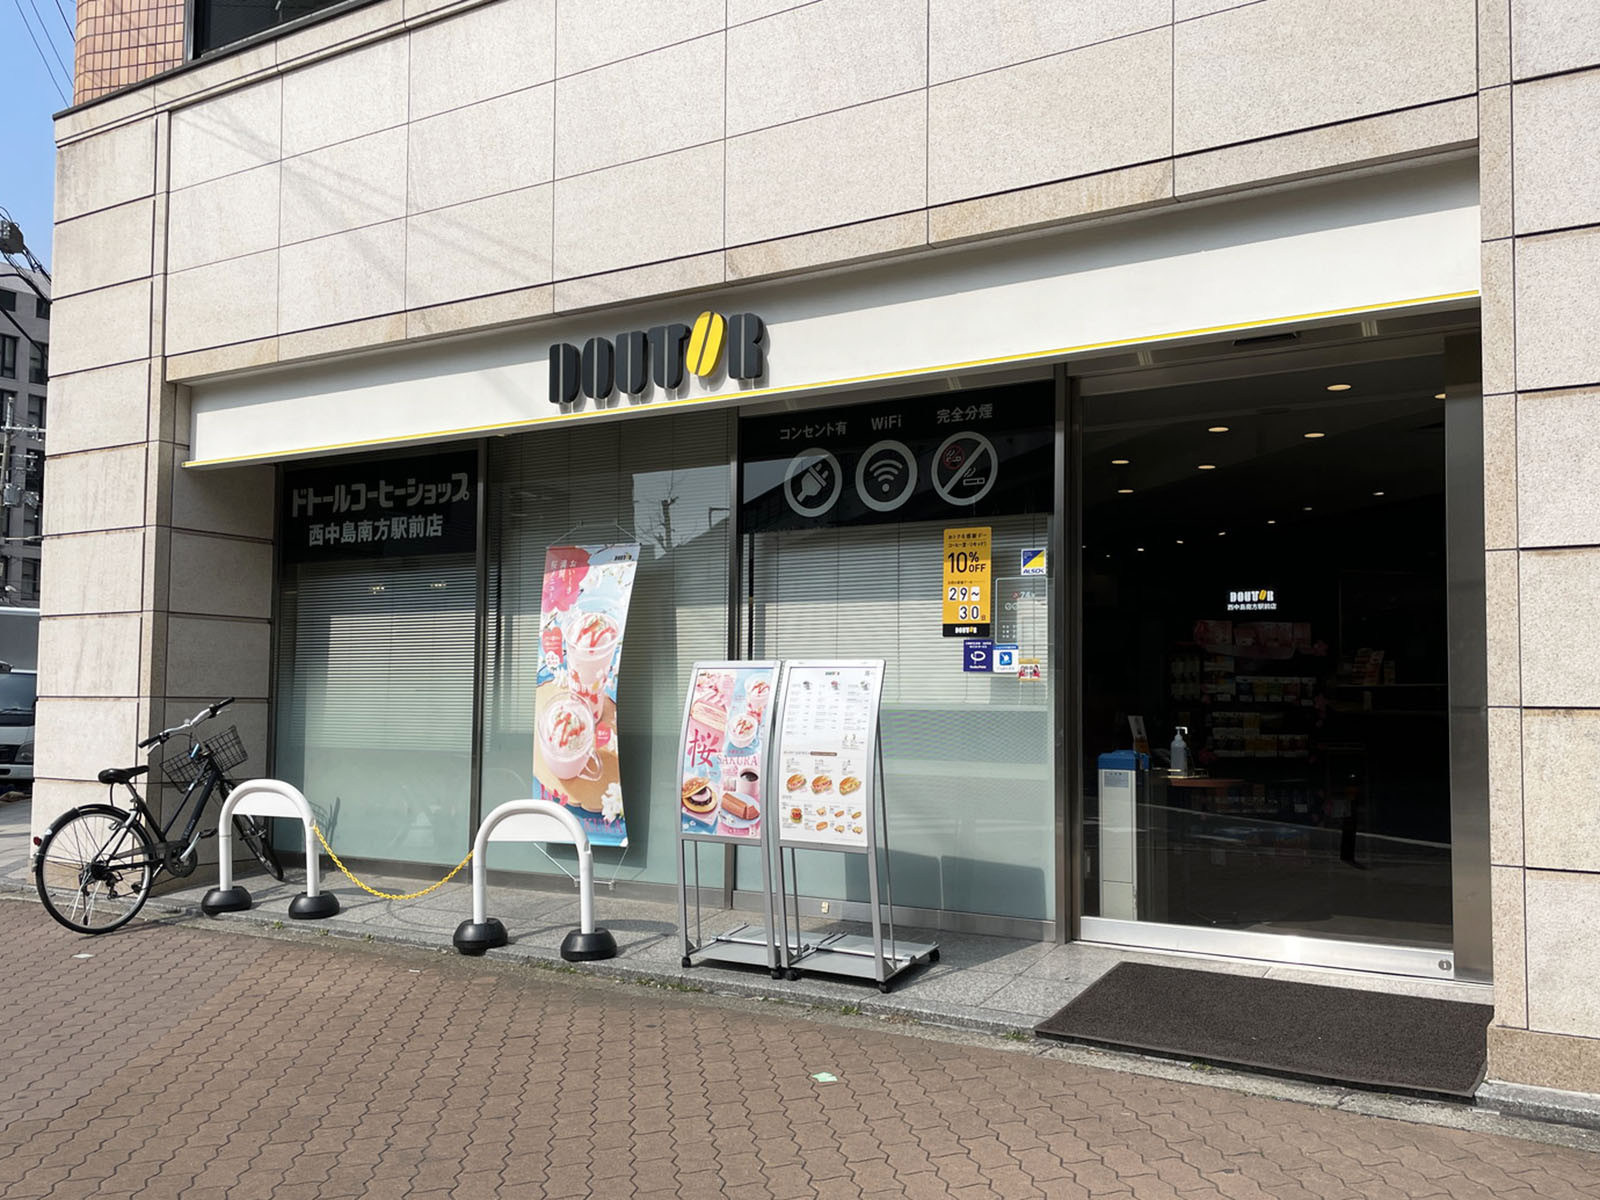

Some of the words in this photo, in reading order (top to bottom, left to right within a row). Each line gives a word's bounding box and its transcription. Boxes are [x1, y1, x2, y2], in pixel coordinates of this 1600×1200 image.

[549, 311, 763, 404] DOUTOR
[871, 414, 902, 431] WiFi
[937, 403, 993, 424] 完全分煙
[780, 421, 848, 440] コンセント有
[292, 473, 470, 518] ドトールコーヒーショップ
[309, 513, 444, 547] 西中島南方駅前店
[948, 551, 980, 573] 10%
[968, 563, 987, 573] OFF
[1230, 589, 1274, 602] DOUTOR
[687, 728, 720, 768] 桜
[716, 754, 759, 767] SAKURA
[583, 817, 624, 834] KURA
